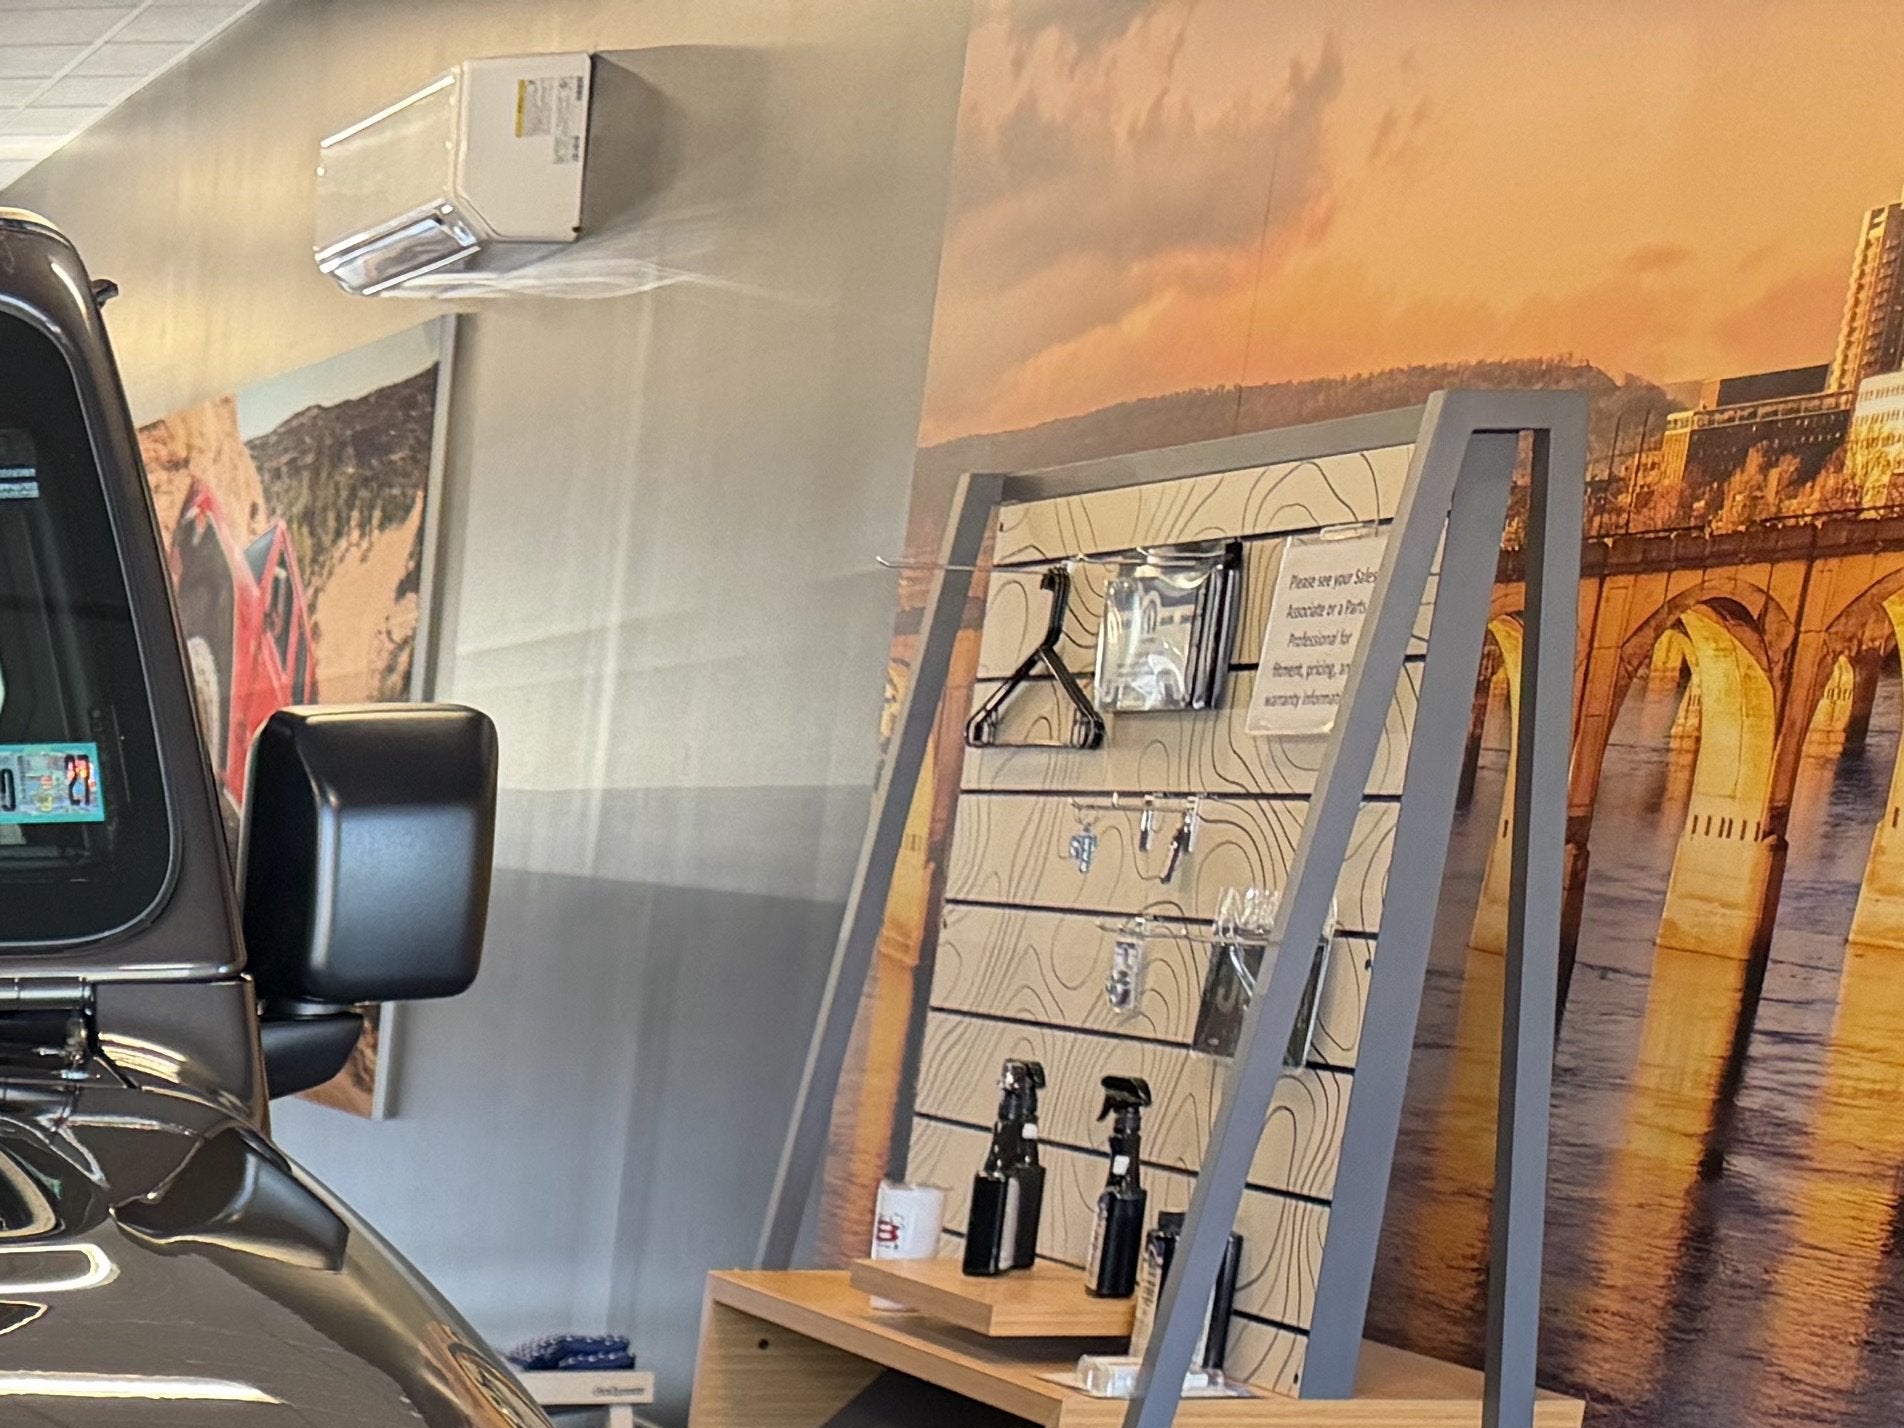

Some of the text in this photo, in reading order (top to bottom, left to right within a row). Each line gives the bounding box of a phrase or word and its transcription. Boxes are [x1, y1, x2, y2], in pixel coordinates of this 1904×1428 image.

[1317, 575, 1332, 588] see
[1333, 573, 1353, 590] your
[1286, 602, 1326, 619] Associate
[1287, 629, 1340, 648] Professional
[64, 754, 90, 806] 27
